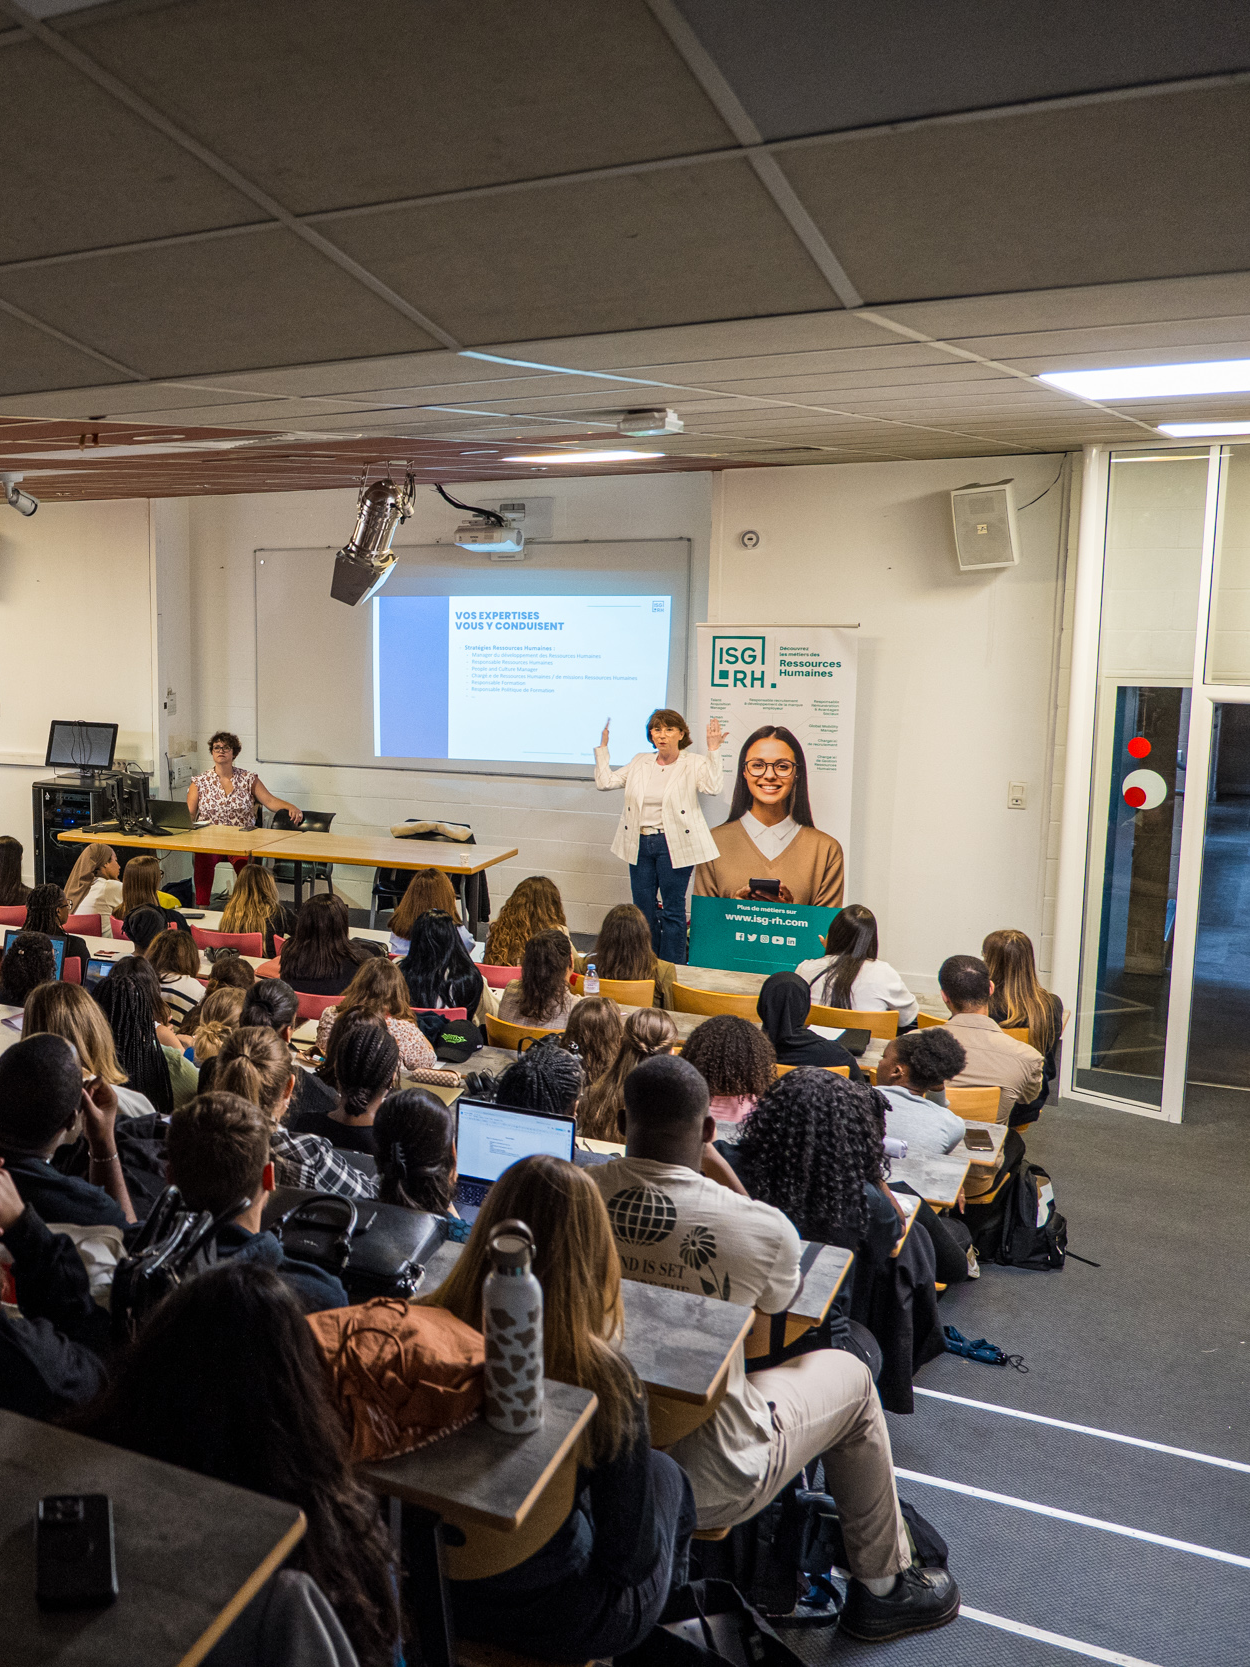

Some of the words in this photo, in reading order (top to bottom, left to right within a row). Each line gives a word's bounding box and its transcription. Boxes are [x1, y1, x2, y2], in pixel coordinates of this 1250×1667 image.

[455, 611, 477, 620] VOS
[478, 611, 540, 620] EXPERTISES
[455, 622, 484, 630] VOUS
[486, 622, 494, 630] Y
[495, 622, 564, 630] CONDUISENT
[718, 646, 757, 665] ISG
[779, 659, 842, 668] Ressources
[779, 669, 833, 678] Humaines
[725, 914, 808, 928] www.isg-rh.com
[642, 1258, 655, 1274] IS
[659, 1262, 686, 1279] SET
